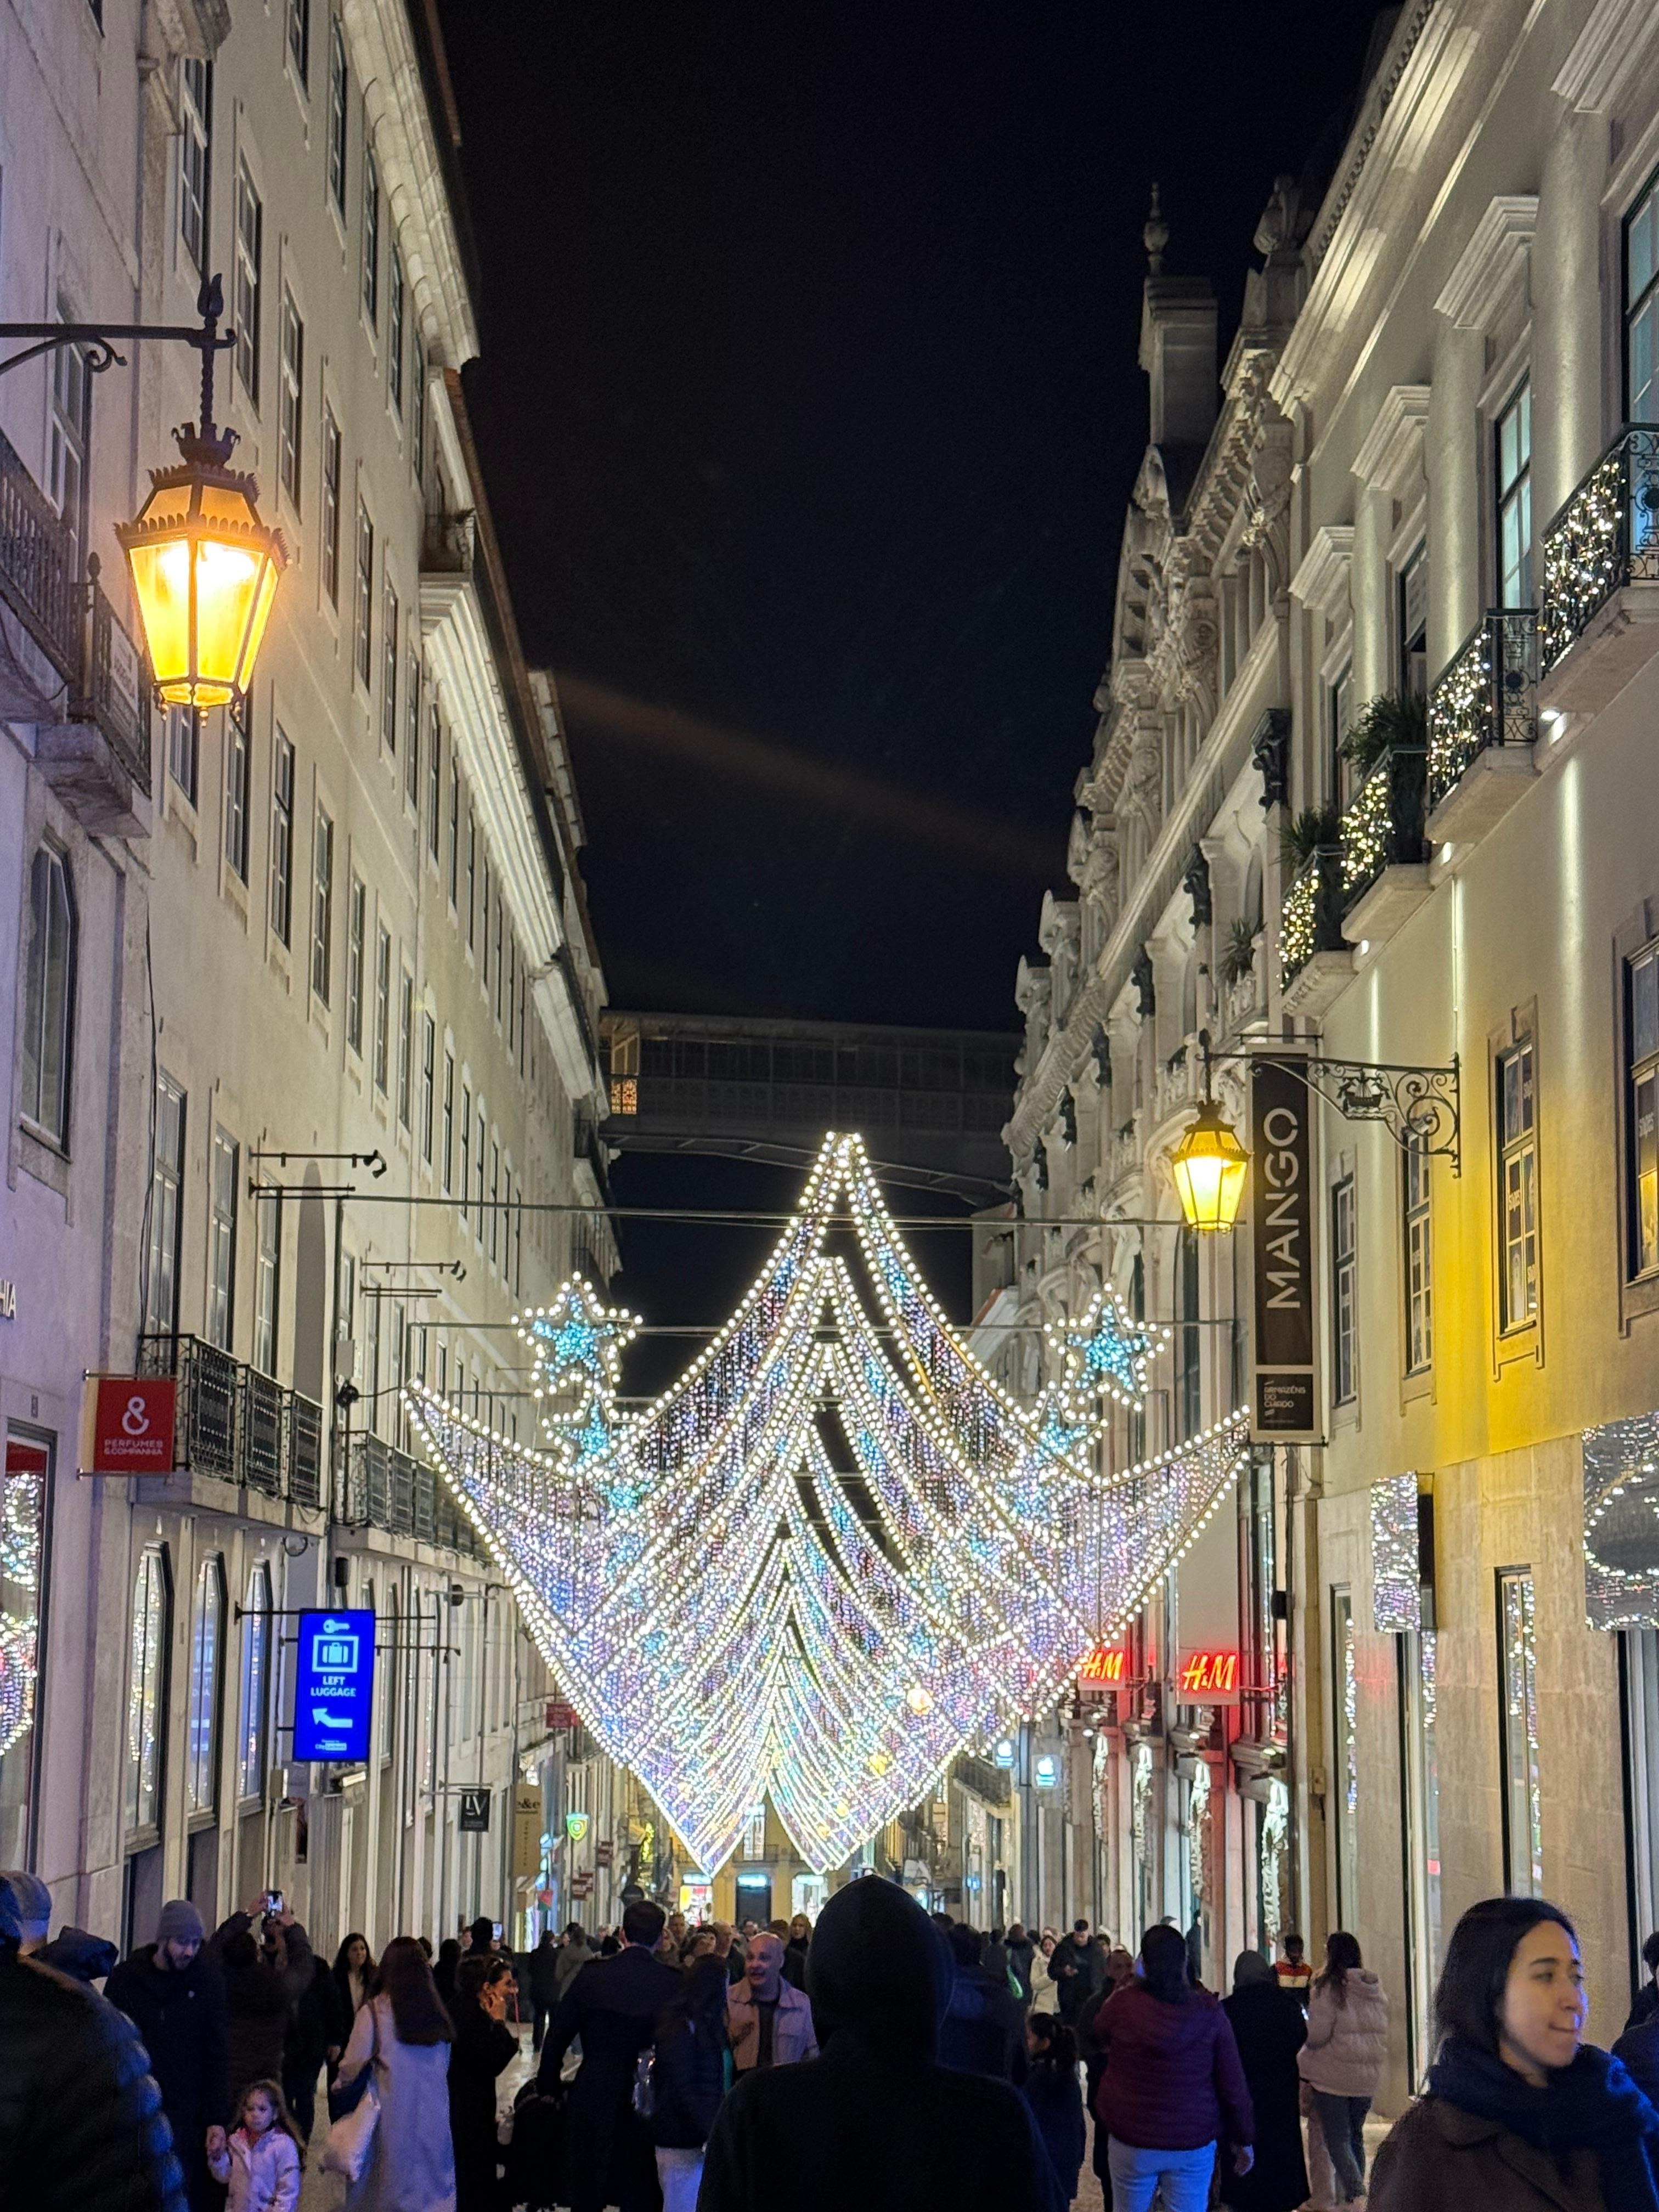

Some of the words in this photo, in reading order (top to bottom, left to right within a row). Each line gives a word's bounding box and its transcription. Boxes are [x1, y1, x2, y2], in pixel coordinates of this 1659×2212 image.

[1263, 1108, 1300, 1308] MANGO
[104, 1439, 163, 1447] PERFUMES
[1082, 1651, 1124, 1680] H&M
[1182, 1654, 1236, 1691] H&M
[323, 1675, 346, 1686] LEFT
[310, 1687, 357, 1697] LUGGAGE
